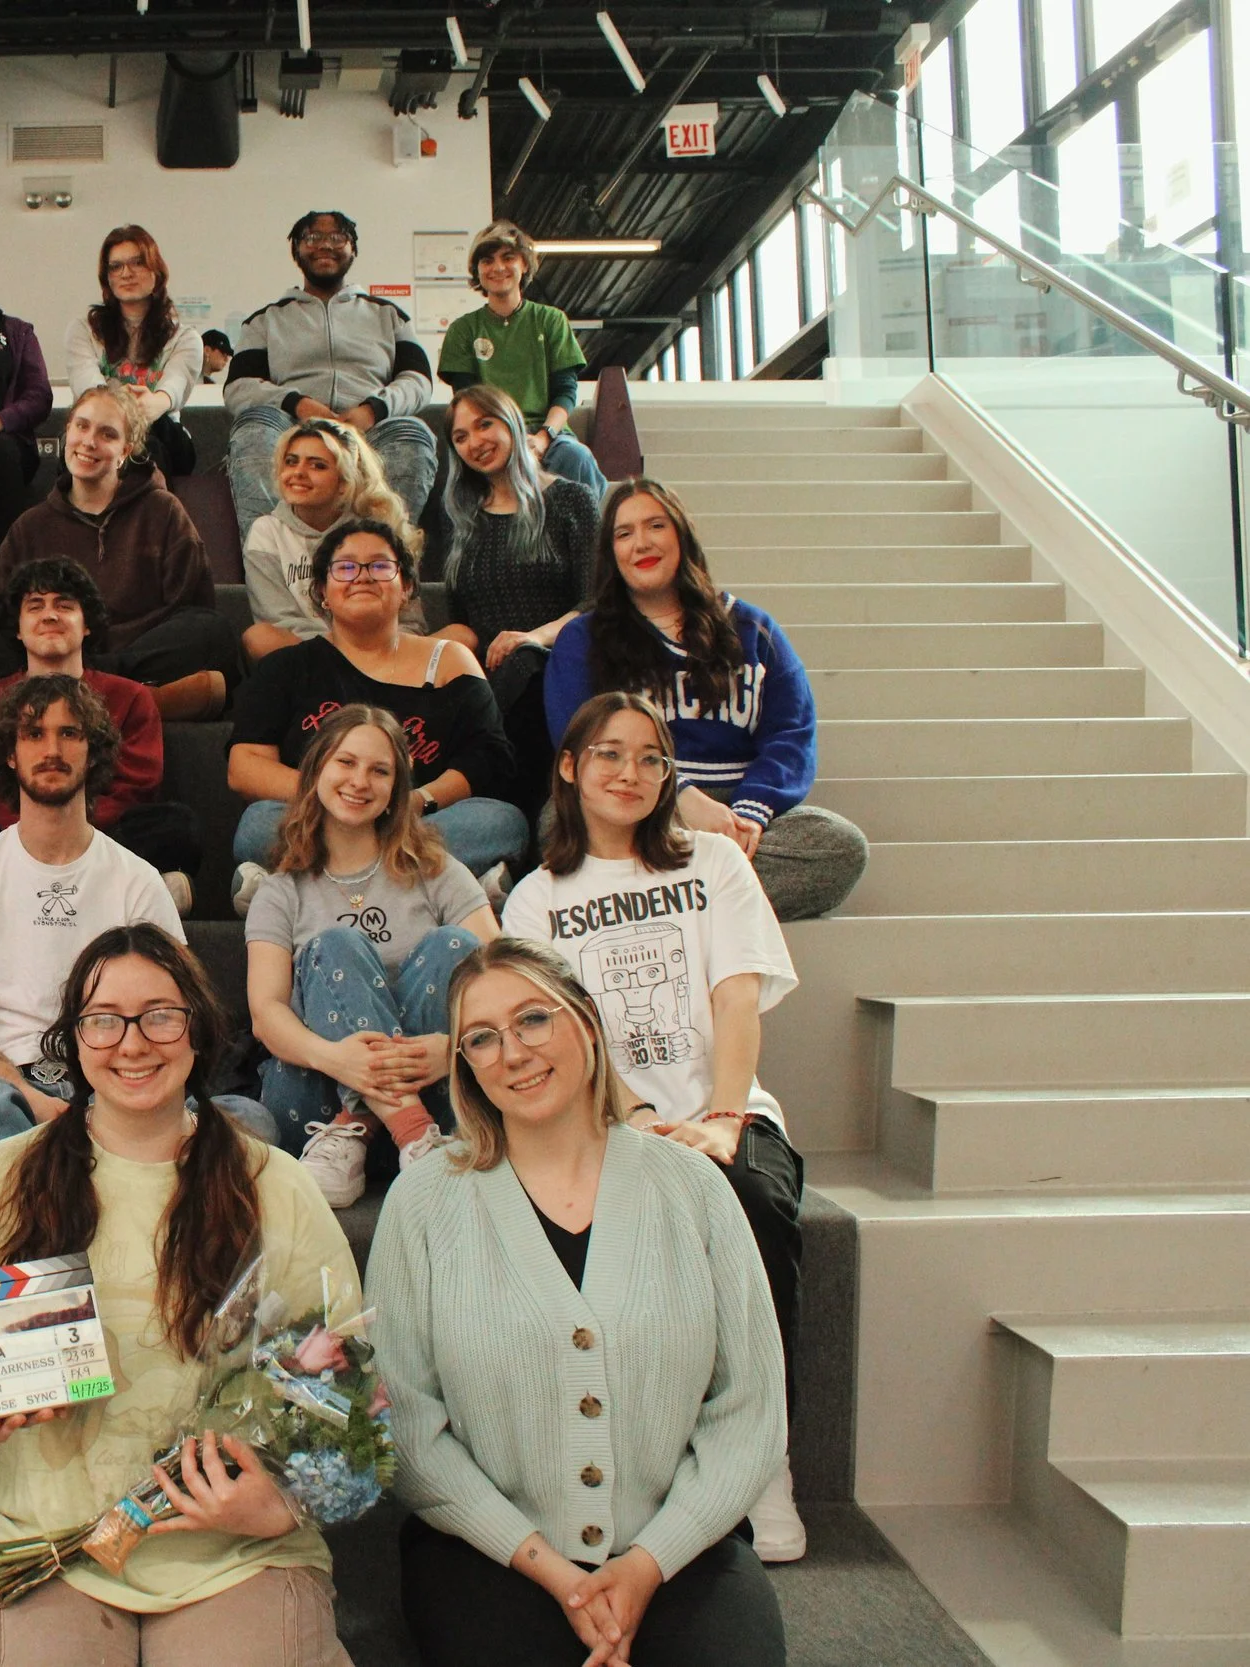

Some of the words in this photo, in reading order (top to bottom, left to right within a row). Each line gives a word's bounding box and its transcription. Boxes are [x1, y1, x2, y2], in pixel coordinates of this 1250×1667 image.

[669, 123, 710, 148] EXIT
[631, 1047, 649, 1065] 20
[654, 1046, 668, 1061] 22
[68, 1327, 80, 1343] 3
[25, 1390, 59, 1406] SYNC
[71, 1381, 110, 1398] 4/7/25
